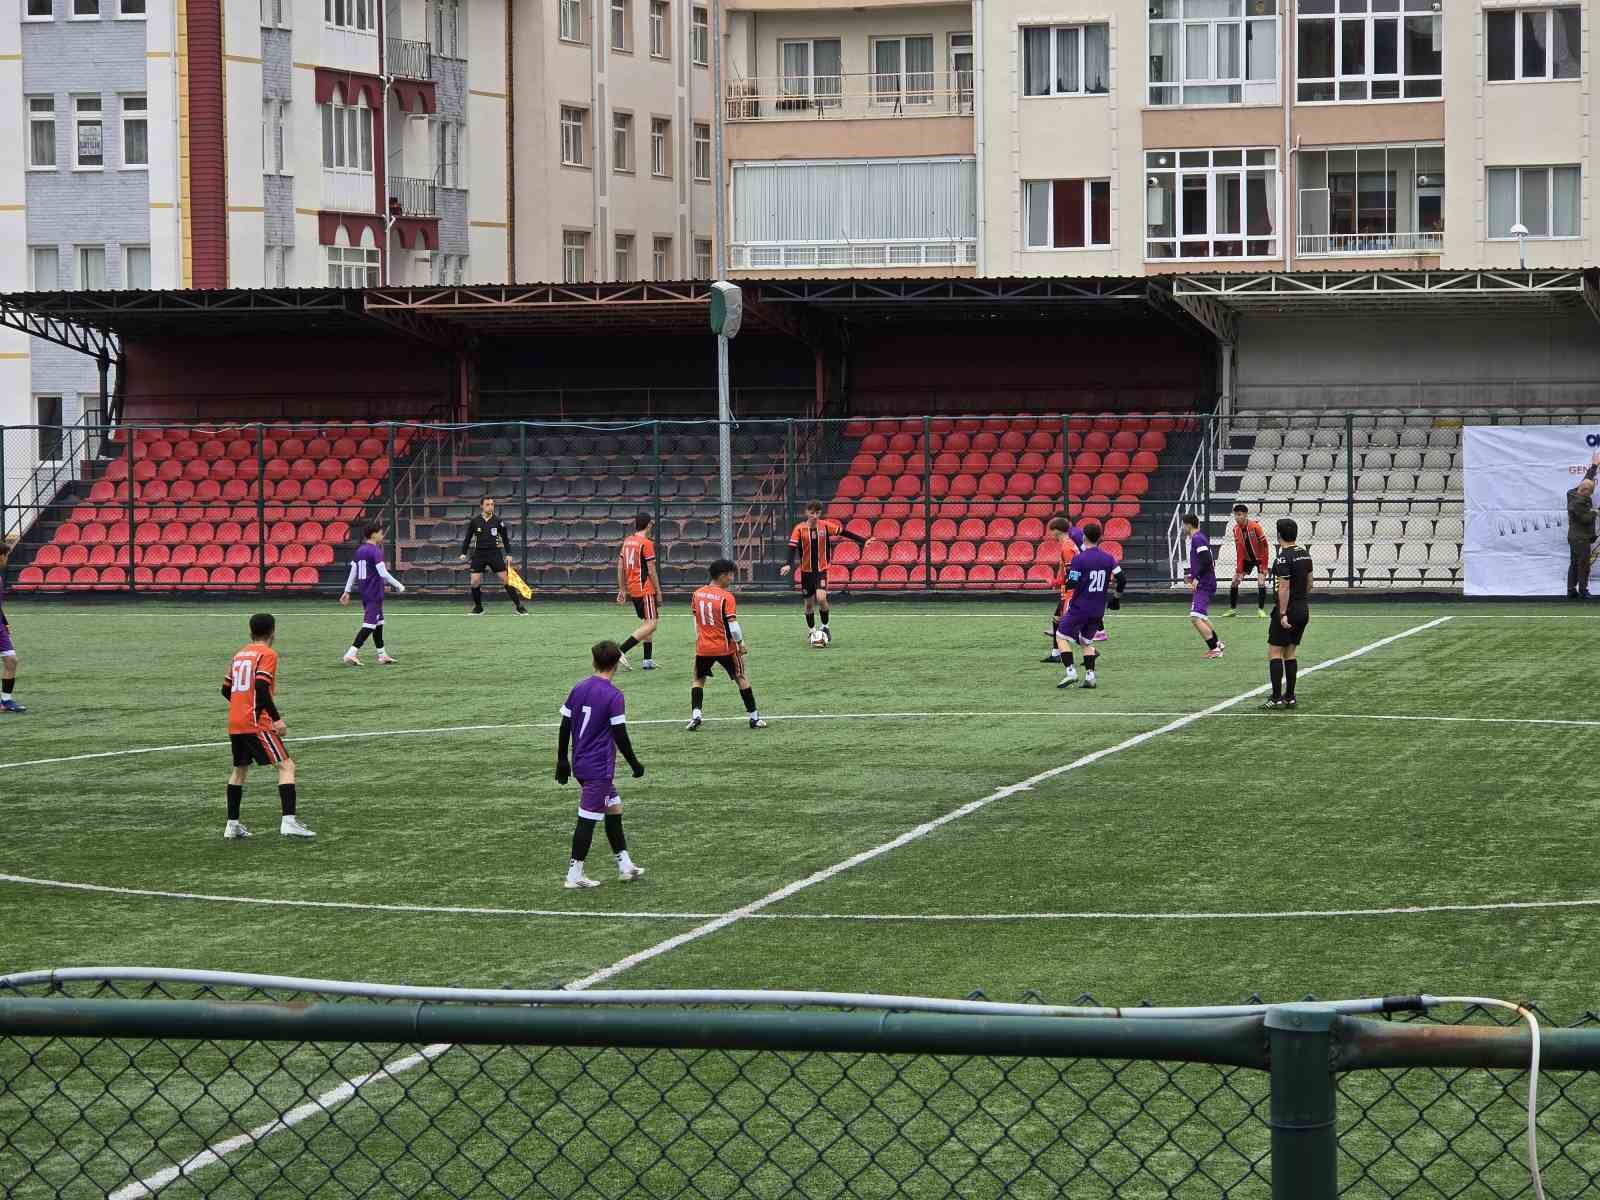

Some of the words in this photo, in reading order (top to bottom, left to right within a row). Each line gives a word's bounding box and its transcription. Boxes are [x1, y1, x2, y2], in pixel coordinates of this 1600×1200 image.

[625, 546, 637, 569] 14
[1088, 569, 1106, 593] 20
[699, 600, 715, 626] 11
[579, 705, 592, 739] 7
